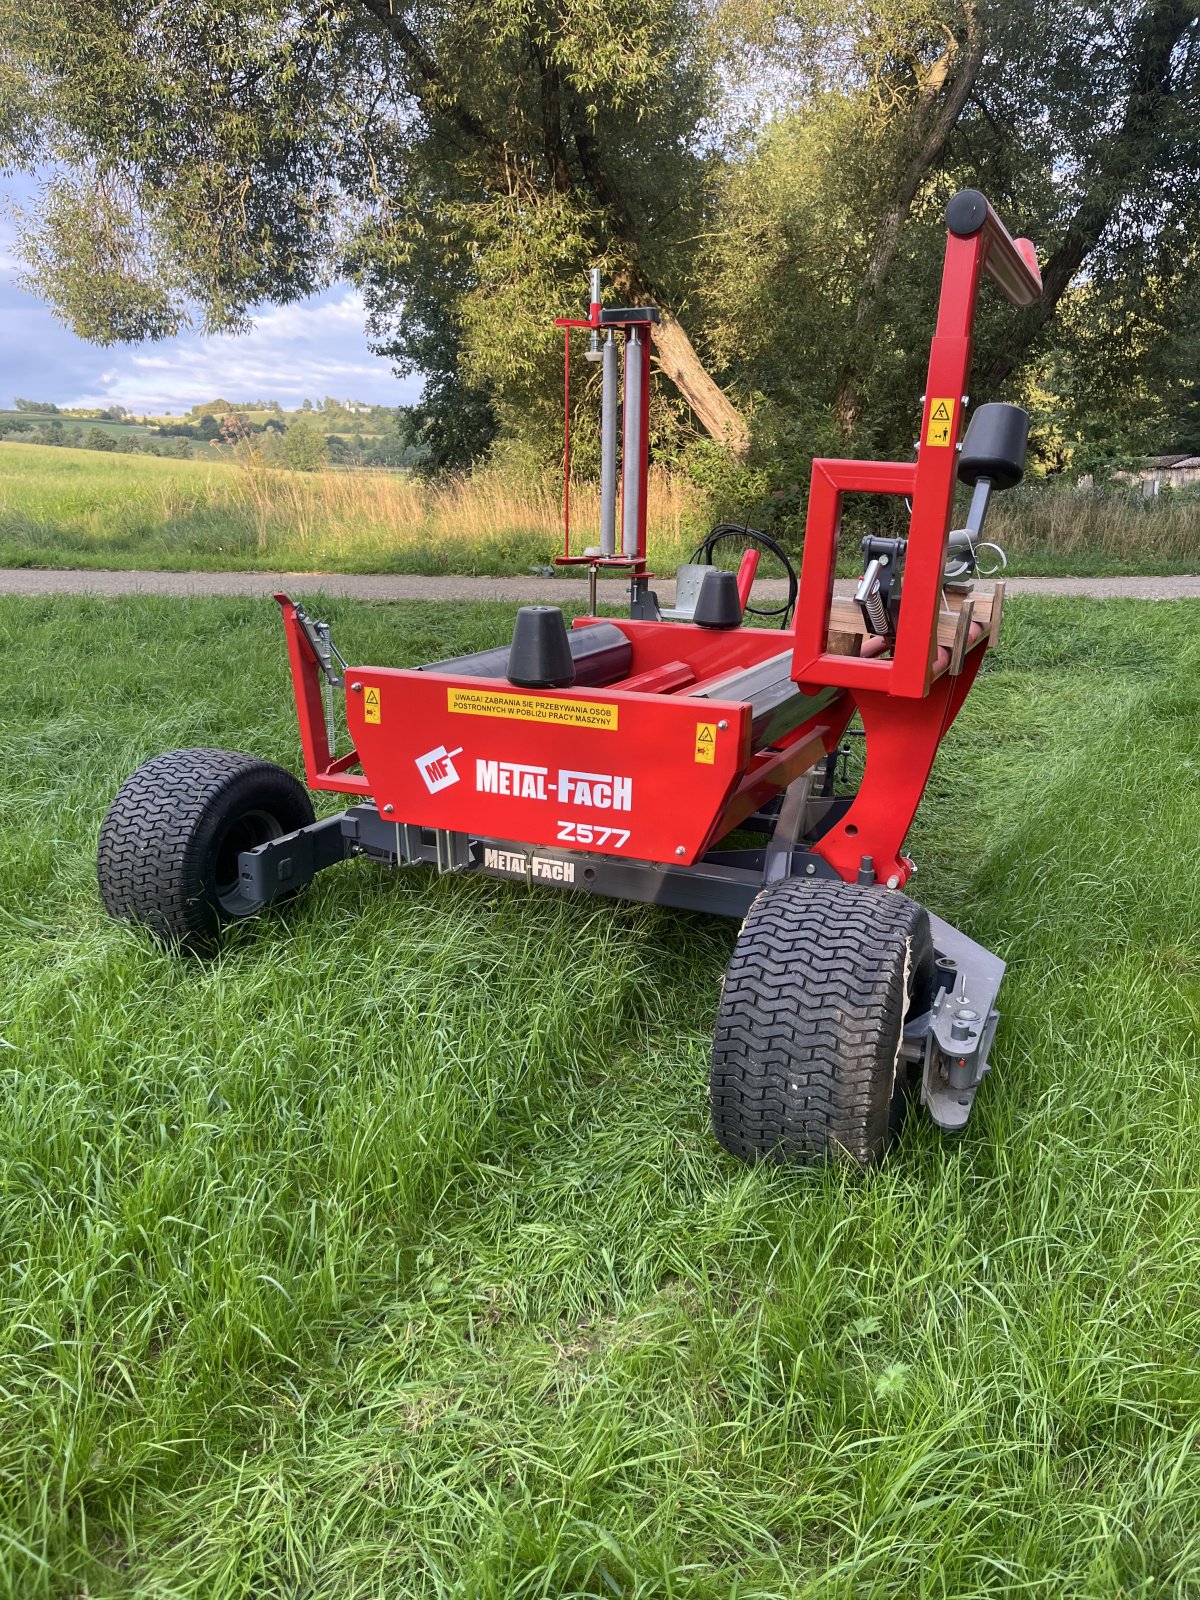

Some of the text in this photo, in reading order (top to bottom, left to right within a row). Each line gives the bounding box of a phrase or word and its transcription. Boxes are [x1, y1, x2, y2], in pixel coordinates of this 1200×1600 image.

[453, 702, 506, 713] POSTRONNYCH
[516, 709, 547, 718] POBLIŻU
[548, 712, 573, 721] PRACY
[575, 715, 611, 725] MASZYNY
[455, 694, 483, 702] UWAGA!
[485, 697, 520, 706] ZABRANIA
[535, 702, 588, 714] PRZEBYWANIA
[589, 708, 611, 716] OSÓB
[424, 755, 449, 783] MF
[557, 820, 631, 848] Z577
